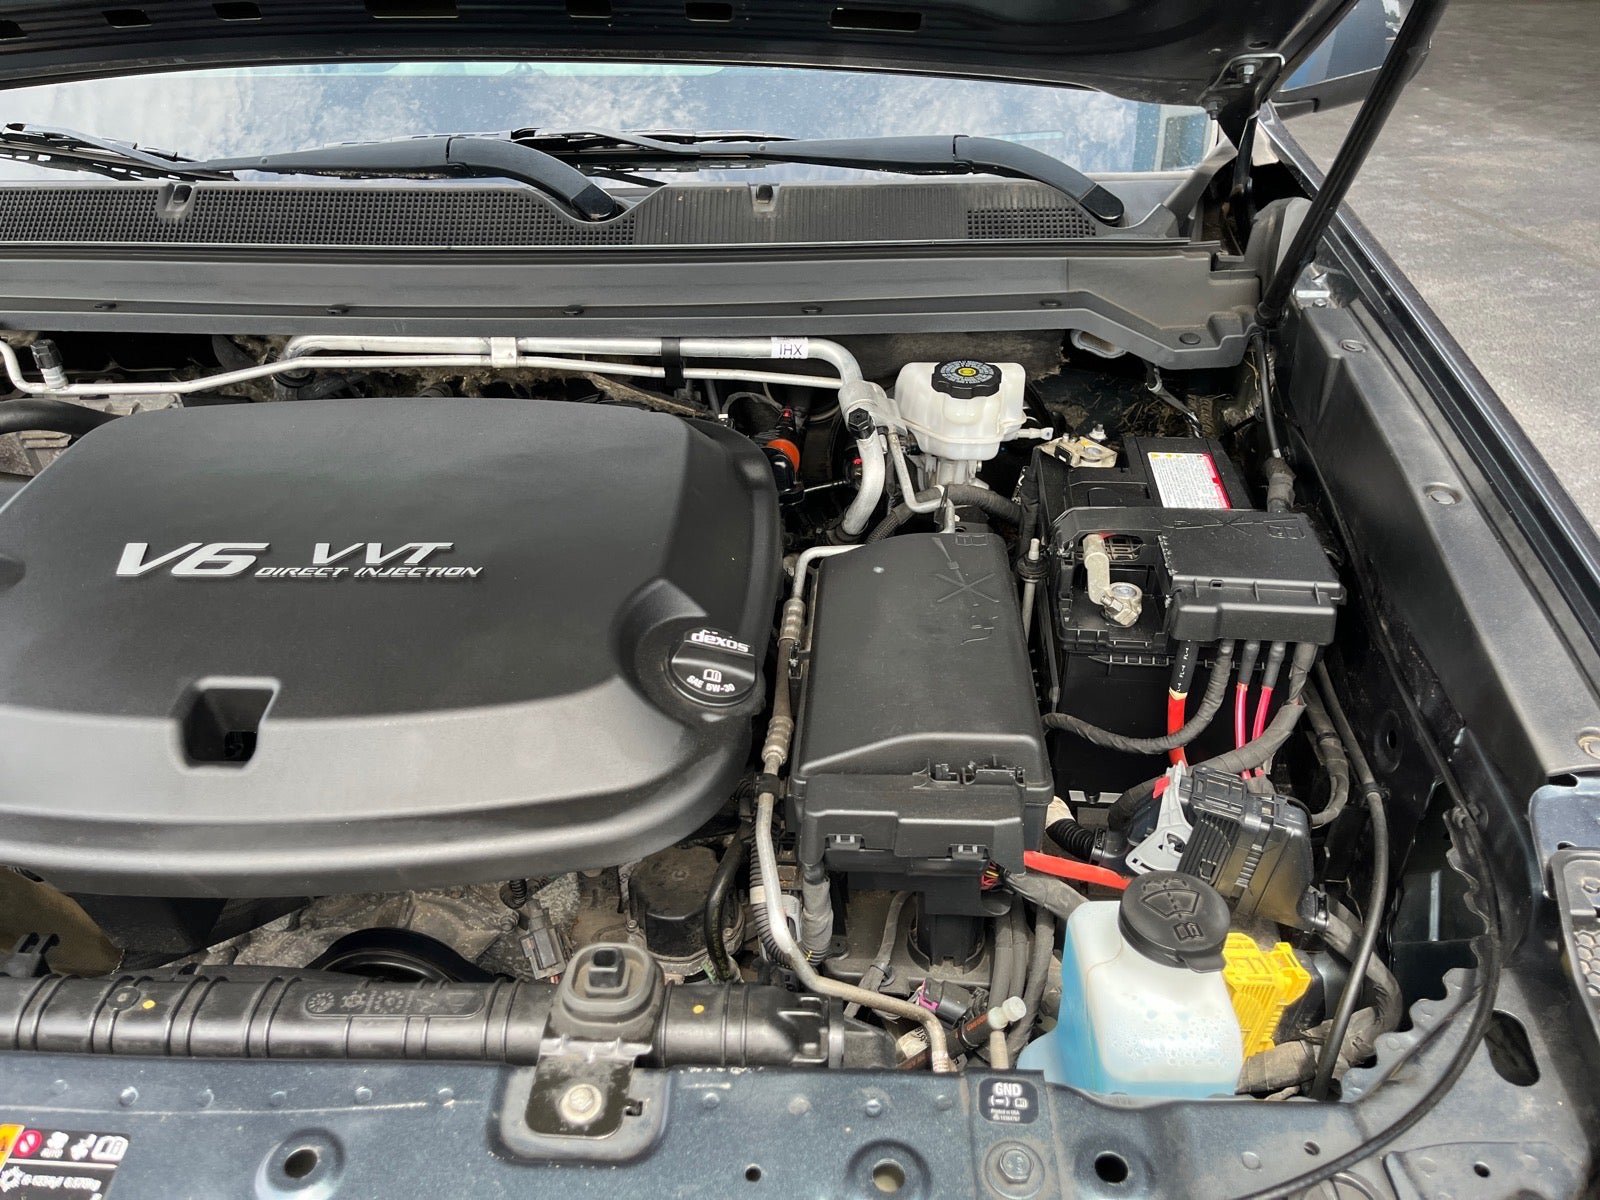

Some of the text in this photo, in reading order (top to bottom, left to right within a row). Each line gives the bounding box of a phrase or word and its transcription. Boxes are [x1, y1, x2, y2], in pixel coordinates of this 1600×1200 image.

[116, 542, 454, 577] V6 VVT
[254, 566, 485, 579] DIRECT INJECTION
[686, 674, 736, 693] SAE 5W-30
[992, 1081, 1022, 1098] GND
